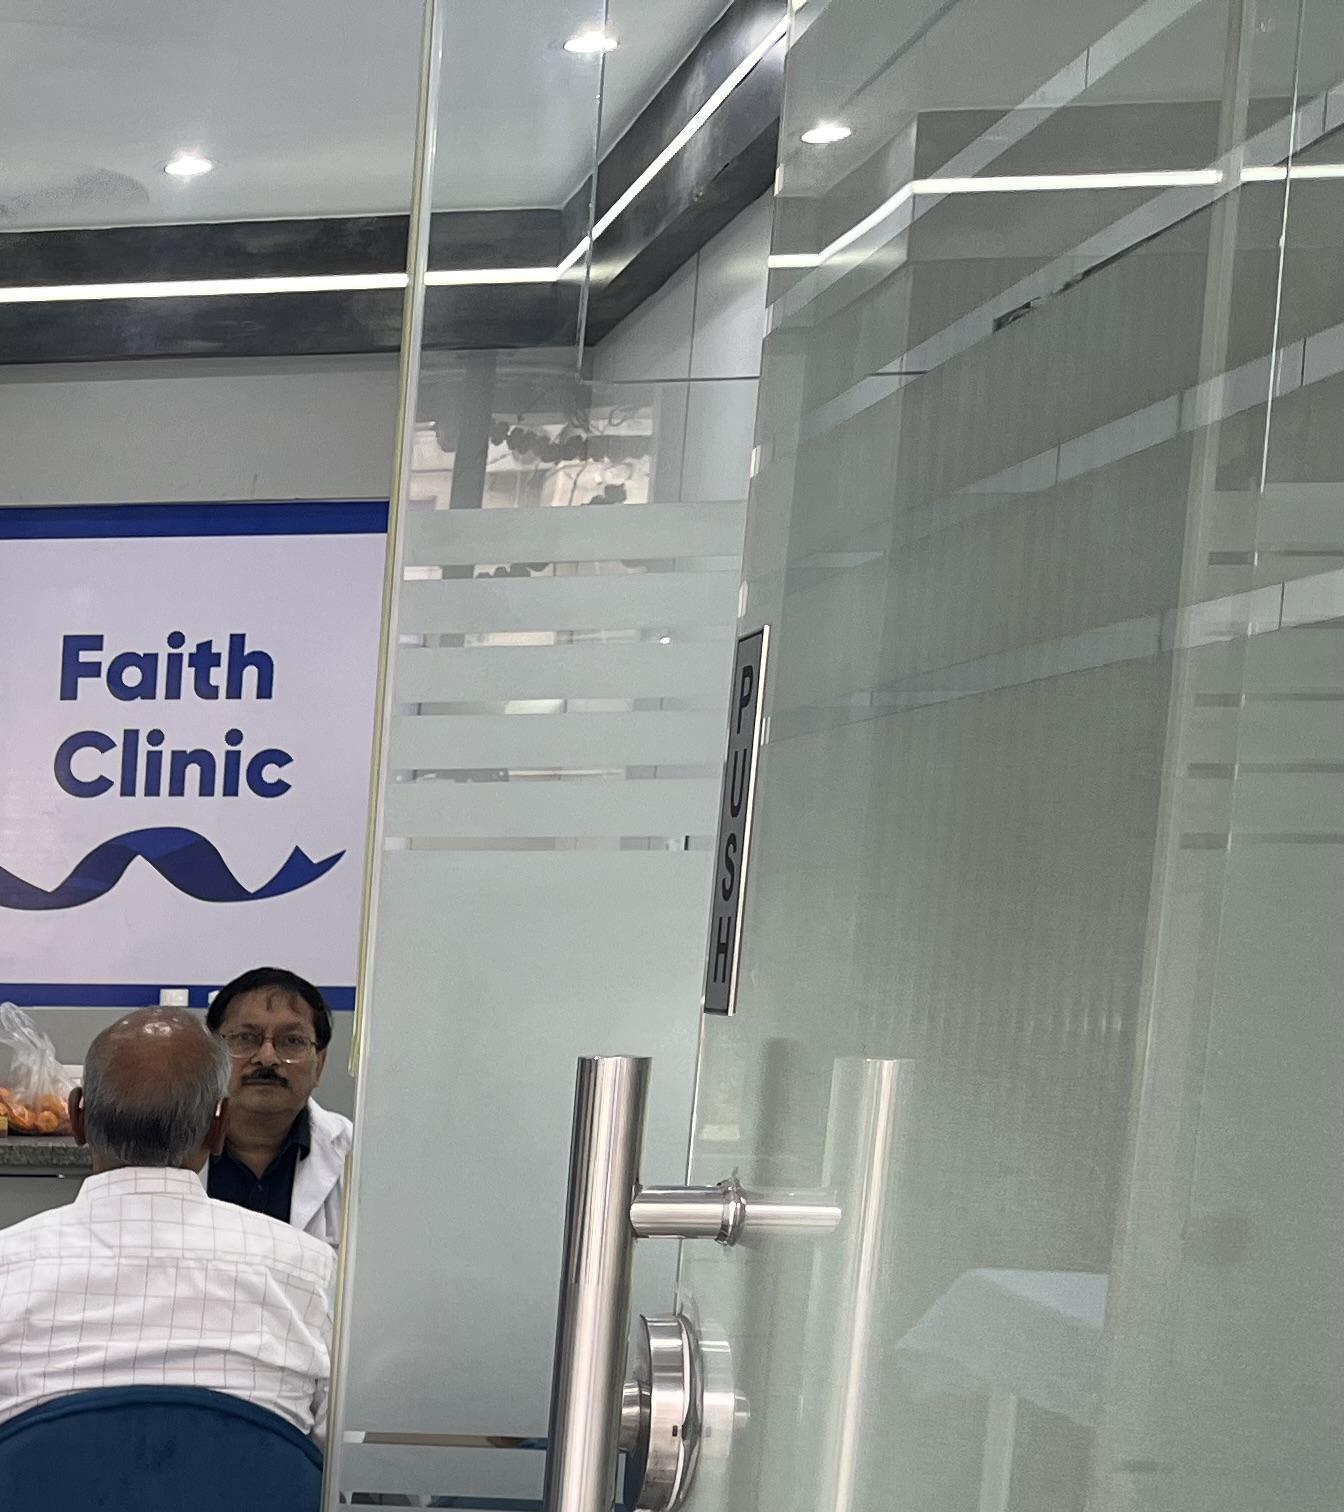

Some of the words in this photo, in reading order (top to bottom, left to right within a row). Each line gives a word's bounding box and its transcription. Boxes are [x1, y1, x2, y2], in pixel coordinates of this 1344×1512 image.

[59, 630, 274, 702] Faith
[53, 728, 294, 799] Clinic
[713, 664, 754, 984] PUSH
